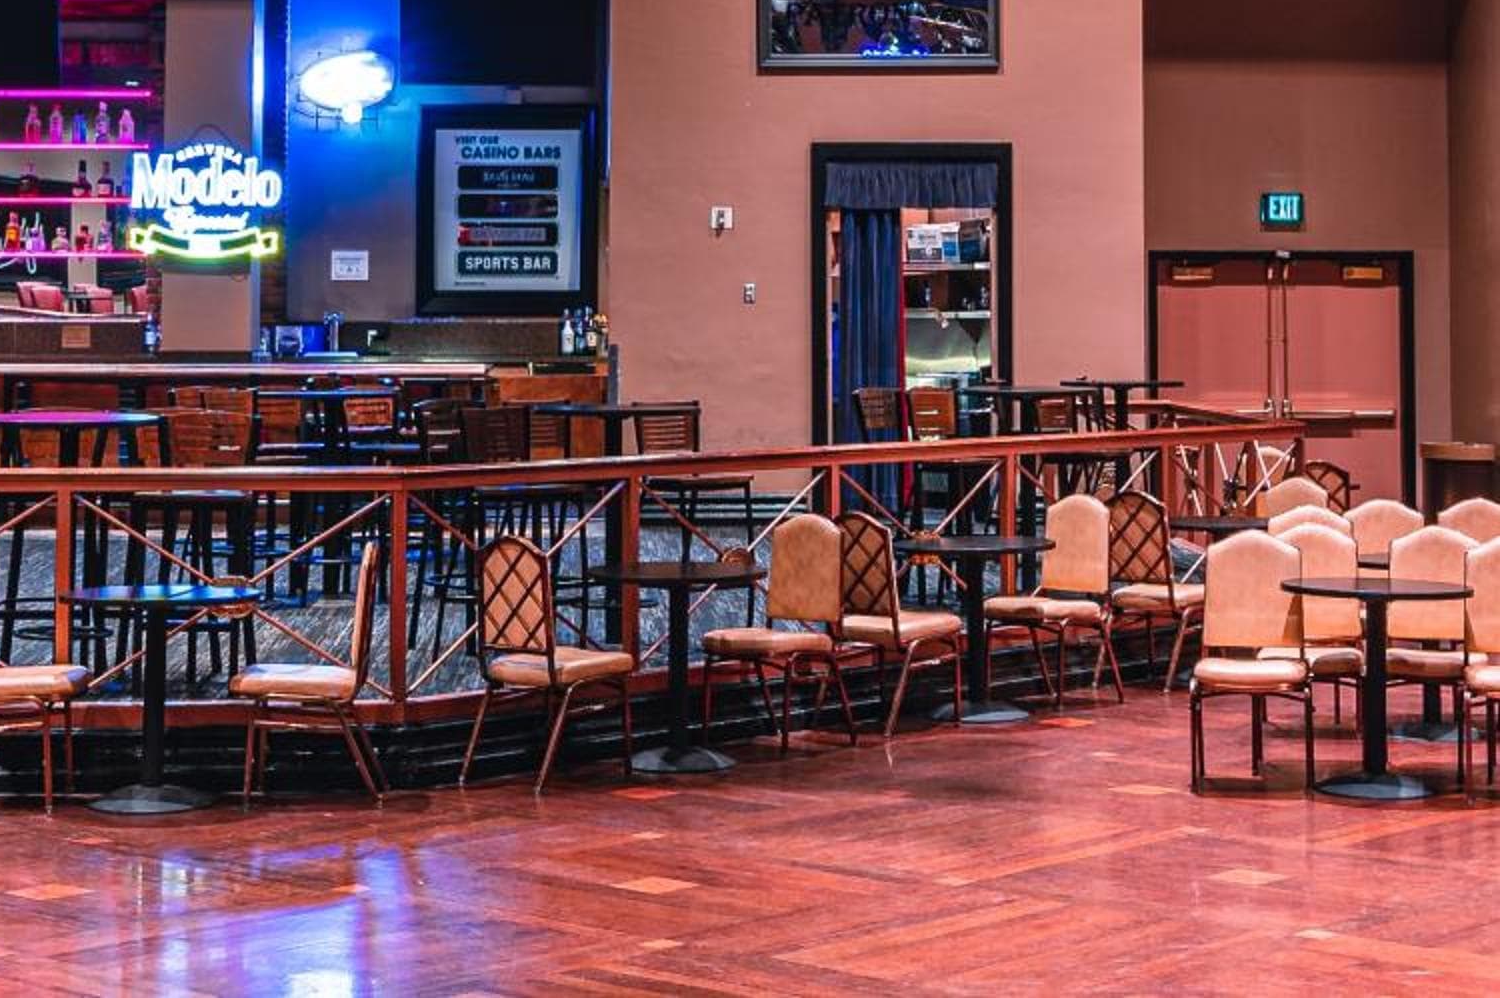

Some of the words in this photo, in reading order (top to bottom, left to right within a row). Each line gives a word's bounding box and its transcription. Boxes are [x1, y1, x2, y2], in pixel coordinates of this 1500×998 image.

[461, 146, 519, 159] CASINO
[523, 146, 561, 159] BARS
[131, 152, 282, 209] Modelo
[1269, 195, 1300, 220] EXIT
[465, 257, 519, 270] SPORTS
[523, 257, 551, 270] BAR
